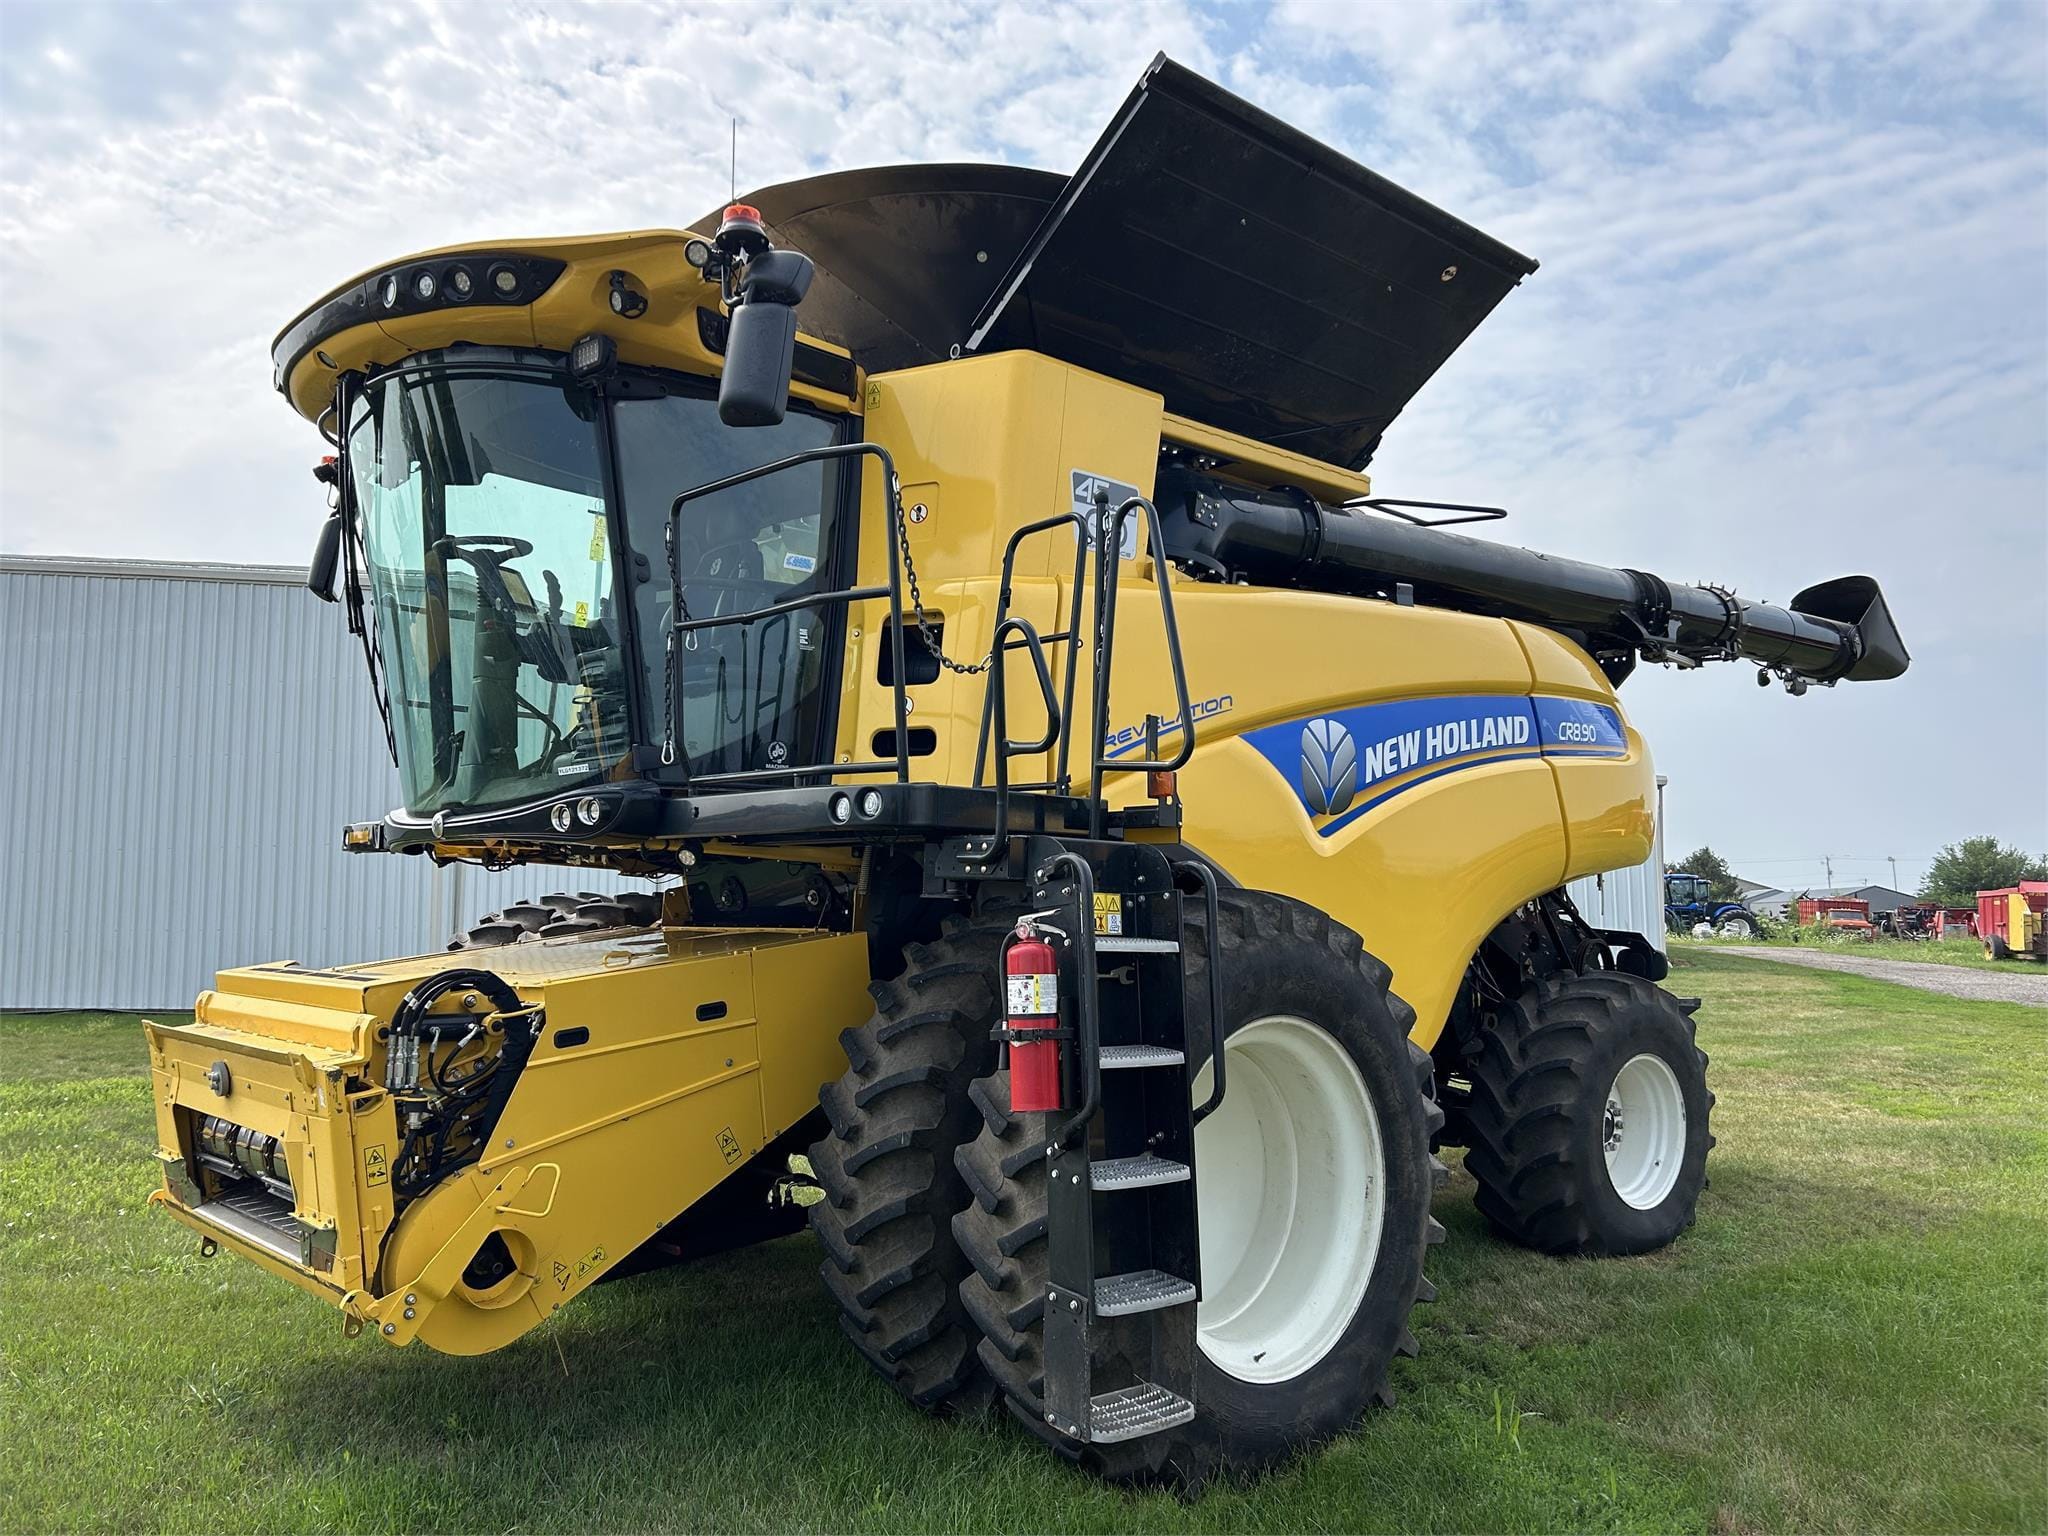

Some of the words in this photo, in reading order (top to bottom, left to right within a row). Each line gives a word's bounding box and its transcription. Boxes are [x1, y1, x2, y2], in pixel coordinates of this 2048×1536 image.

[1365, 730, 1421, 784] NEW
[1426, 715, 1530, 761] HOLLAND
[1558, 722, 1597, 743] CR8.90
